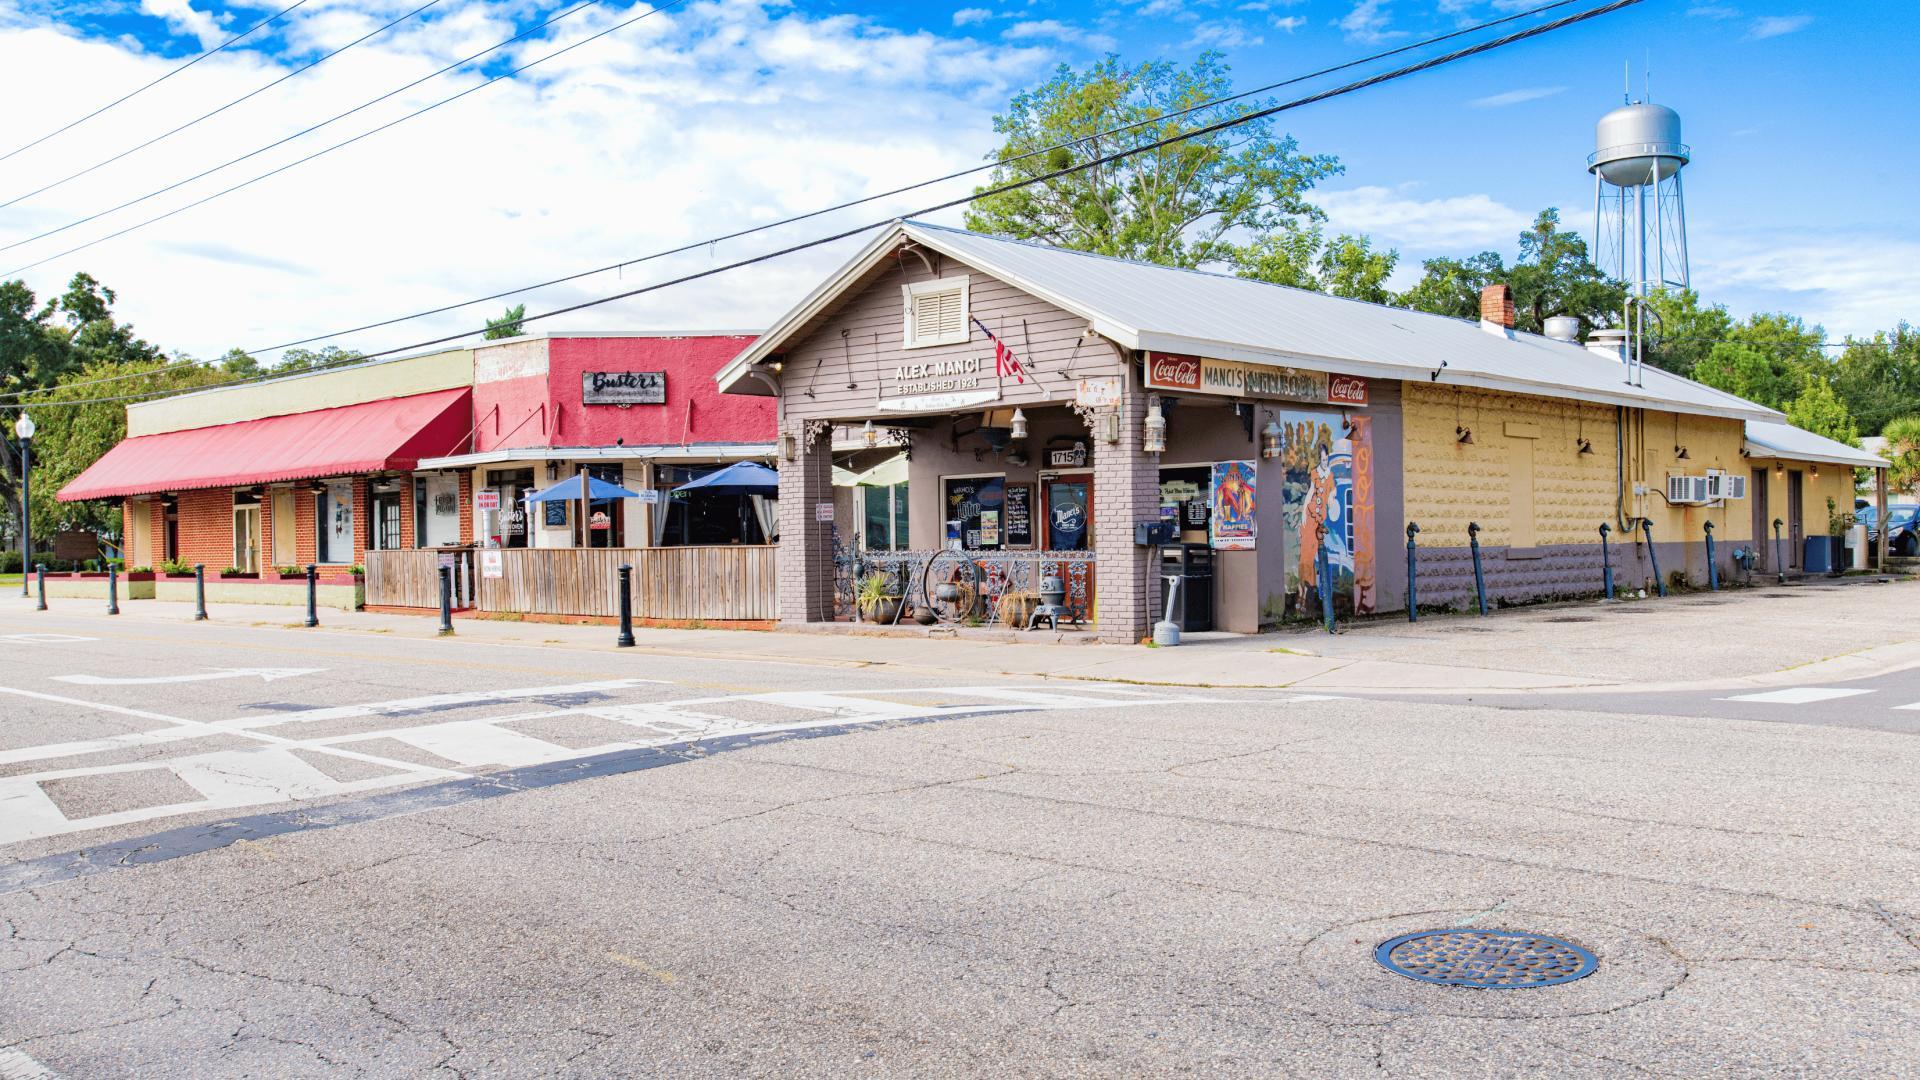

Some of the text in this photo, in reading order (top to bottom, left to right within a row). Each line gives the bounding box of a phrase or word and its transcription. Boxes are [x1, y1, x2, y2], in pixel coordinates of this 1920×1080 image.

[896, 358, 981, 380] ALEX MANCI
[1153, 359, 1198, 385] Coca-Cola
[1204, 366, 1243, 388] MANCI'S
[897, 377, 979, 394] ESTABLISHED 1924
[1331, 378, 1365, 401] Coca-Cola
[1052, 452, 1073, 463] 1715
[1054, 506, 1080, 526] Manci's
